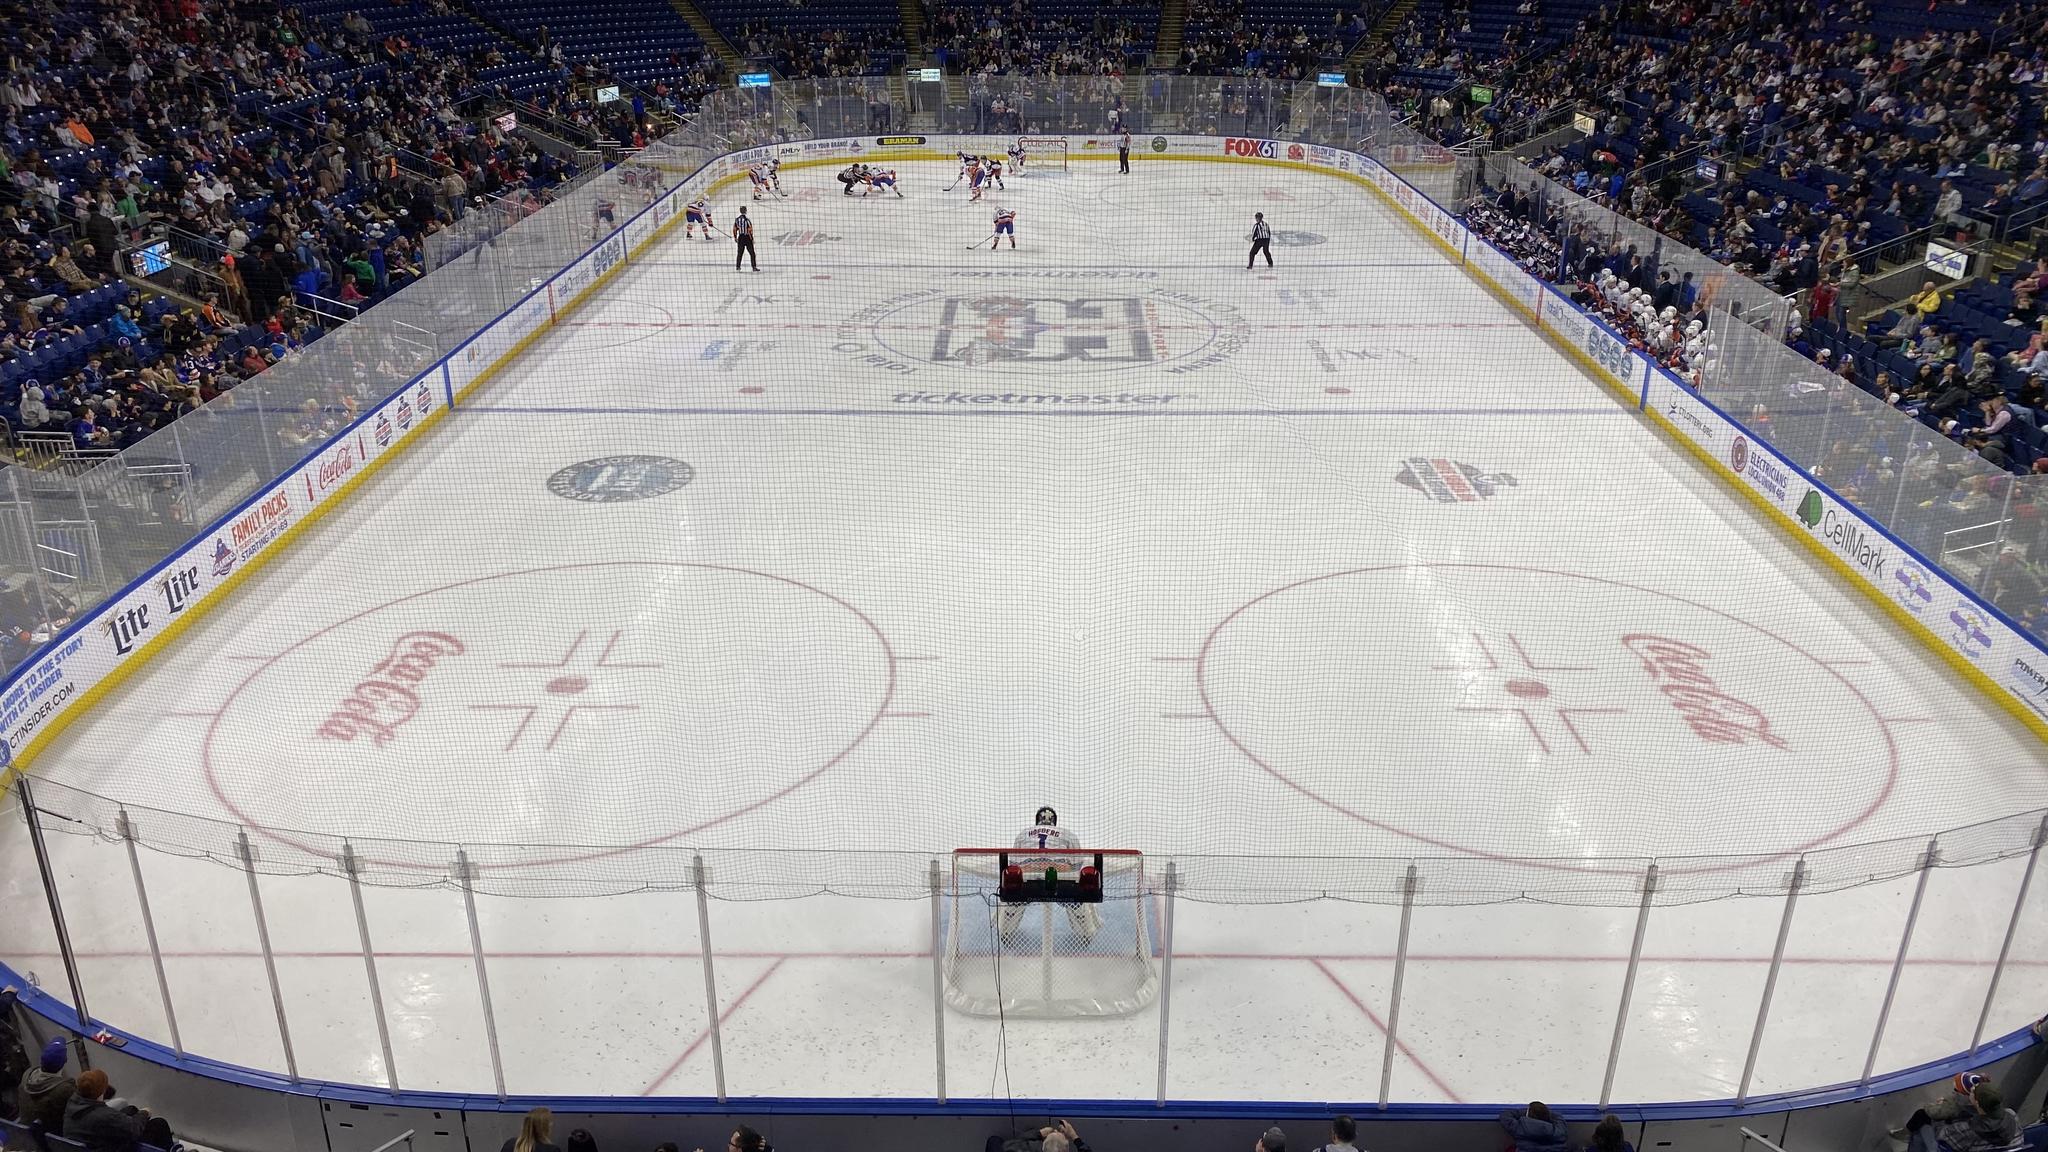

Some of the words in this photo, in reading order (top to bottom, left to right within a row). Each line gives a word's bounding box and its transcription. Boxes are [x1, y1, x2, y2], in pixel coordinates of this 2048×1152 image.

[892, 390, 1181, 404] ticketmaster
[1748, 466, 1760, 482] LOCAL
[1751, 451, 1788, 489] ELECTRICIANS
[231, 508, 261, 547] FAMILY
[261, 490, 288, 524] PACKS
[241, 534, 270, 562] STARTING
[1824, 509, 1887, 580] CellMark
[163, 566, 200, 614] Lite
[110, 603, 151, 657] Lite
[3, 684, 26, 712] MORE
[25, 674, 37, 690] TO
[36, 660, 56, 679] THE
[54, 636, 84, 666] STORY
[2015, 658, 2046, 686] POWER
[0, 707, 19, 734] WITH
[18, 696, 29, 714] CT
[29, 668, 63, 703] INSIDER
[9, 681, 76, 749] CTINSIDER.COM
